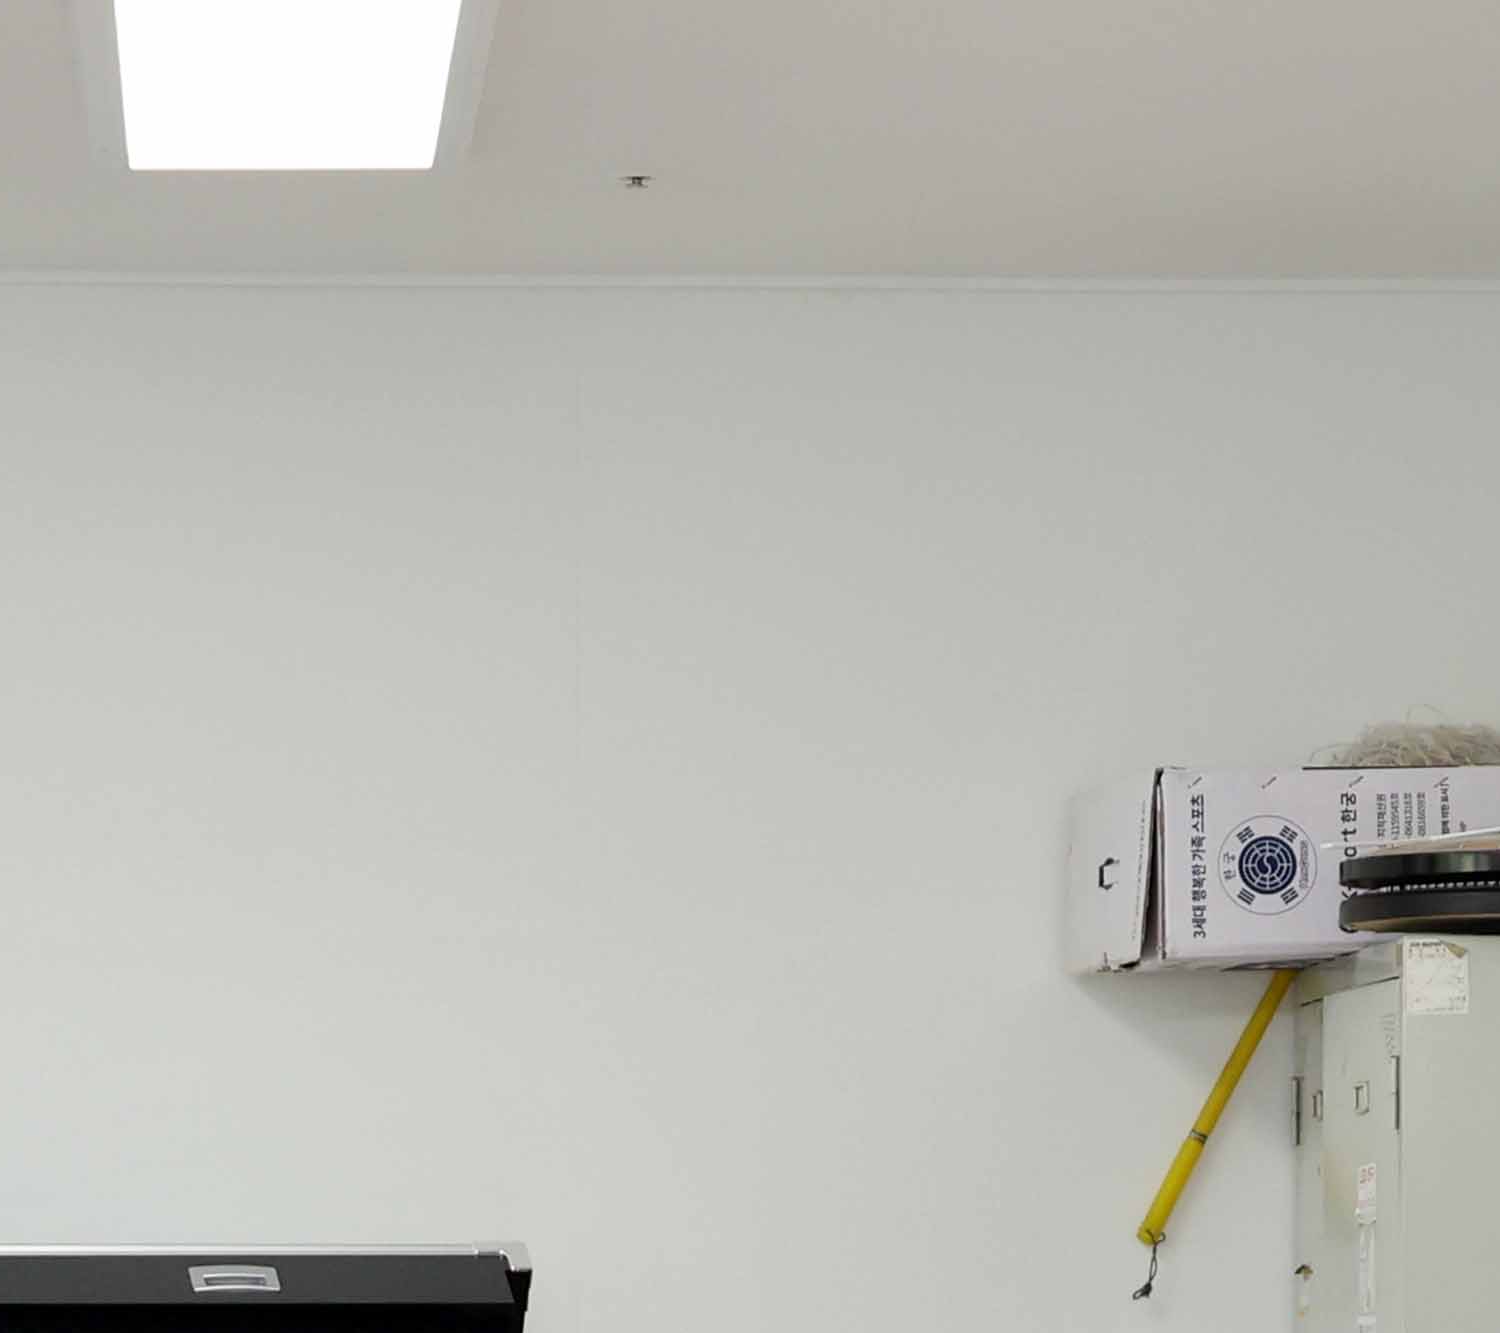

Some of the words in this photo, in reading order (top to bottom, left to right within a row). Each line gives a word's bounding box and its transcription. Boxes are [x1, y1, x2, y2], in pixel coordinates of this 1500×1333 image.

[1190, 793, 1205, 833] 스포츠
[1341, 792, 1358, 823] 한궁
[1190, 836, 1207, 861] 가족
[1191, 864, 1207, 902] 행복한
[1191, 905, 1207, 938] 3세대
